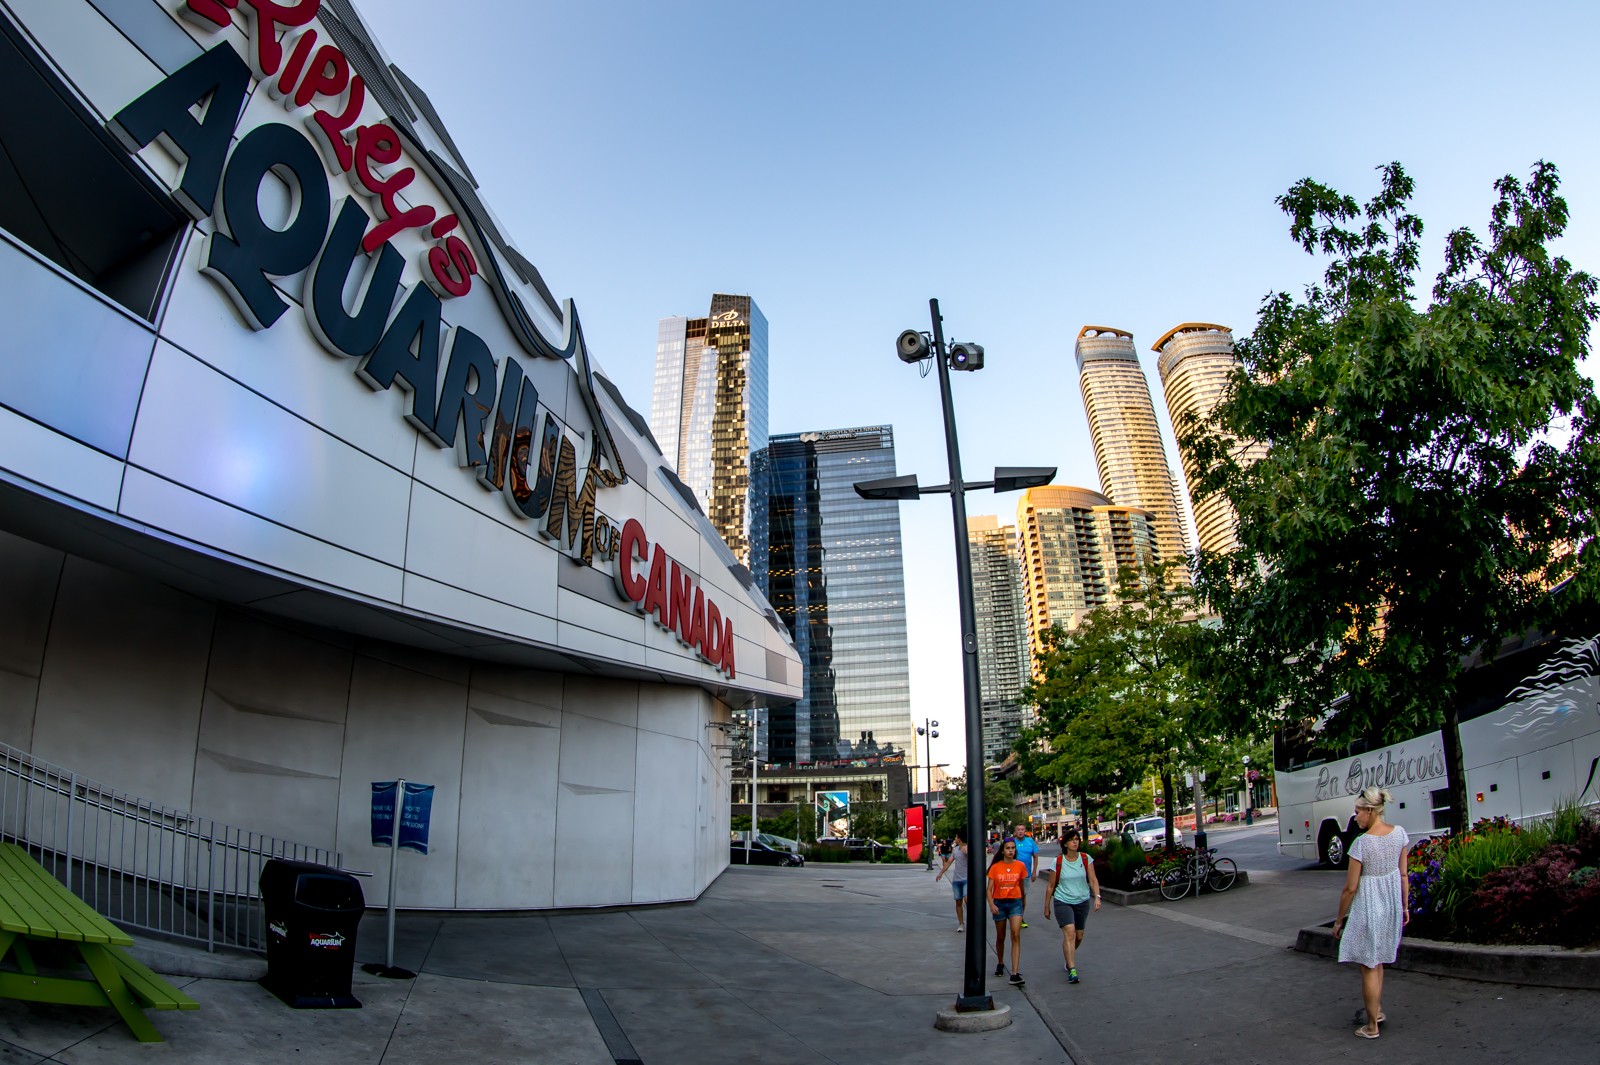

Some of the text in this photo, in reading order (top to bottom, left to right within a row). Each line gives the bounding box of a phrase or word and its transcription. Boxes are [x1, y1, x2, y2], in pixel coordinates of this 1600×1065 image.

[107, 40, 600, 567] AQUARIUM
[711, 319, 745, 329] DELTA
[594, 515, 621, 561] OF
[615, 518, 735, 679] CANADA
[310, 938, 342, 946] AQUARIUM
